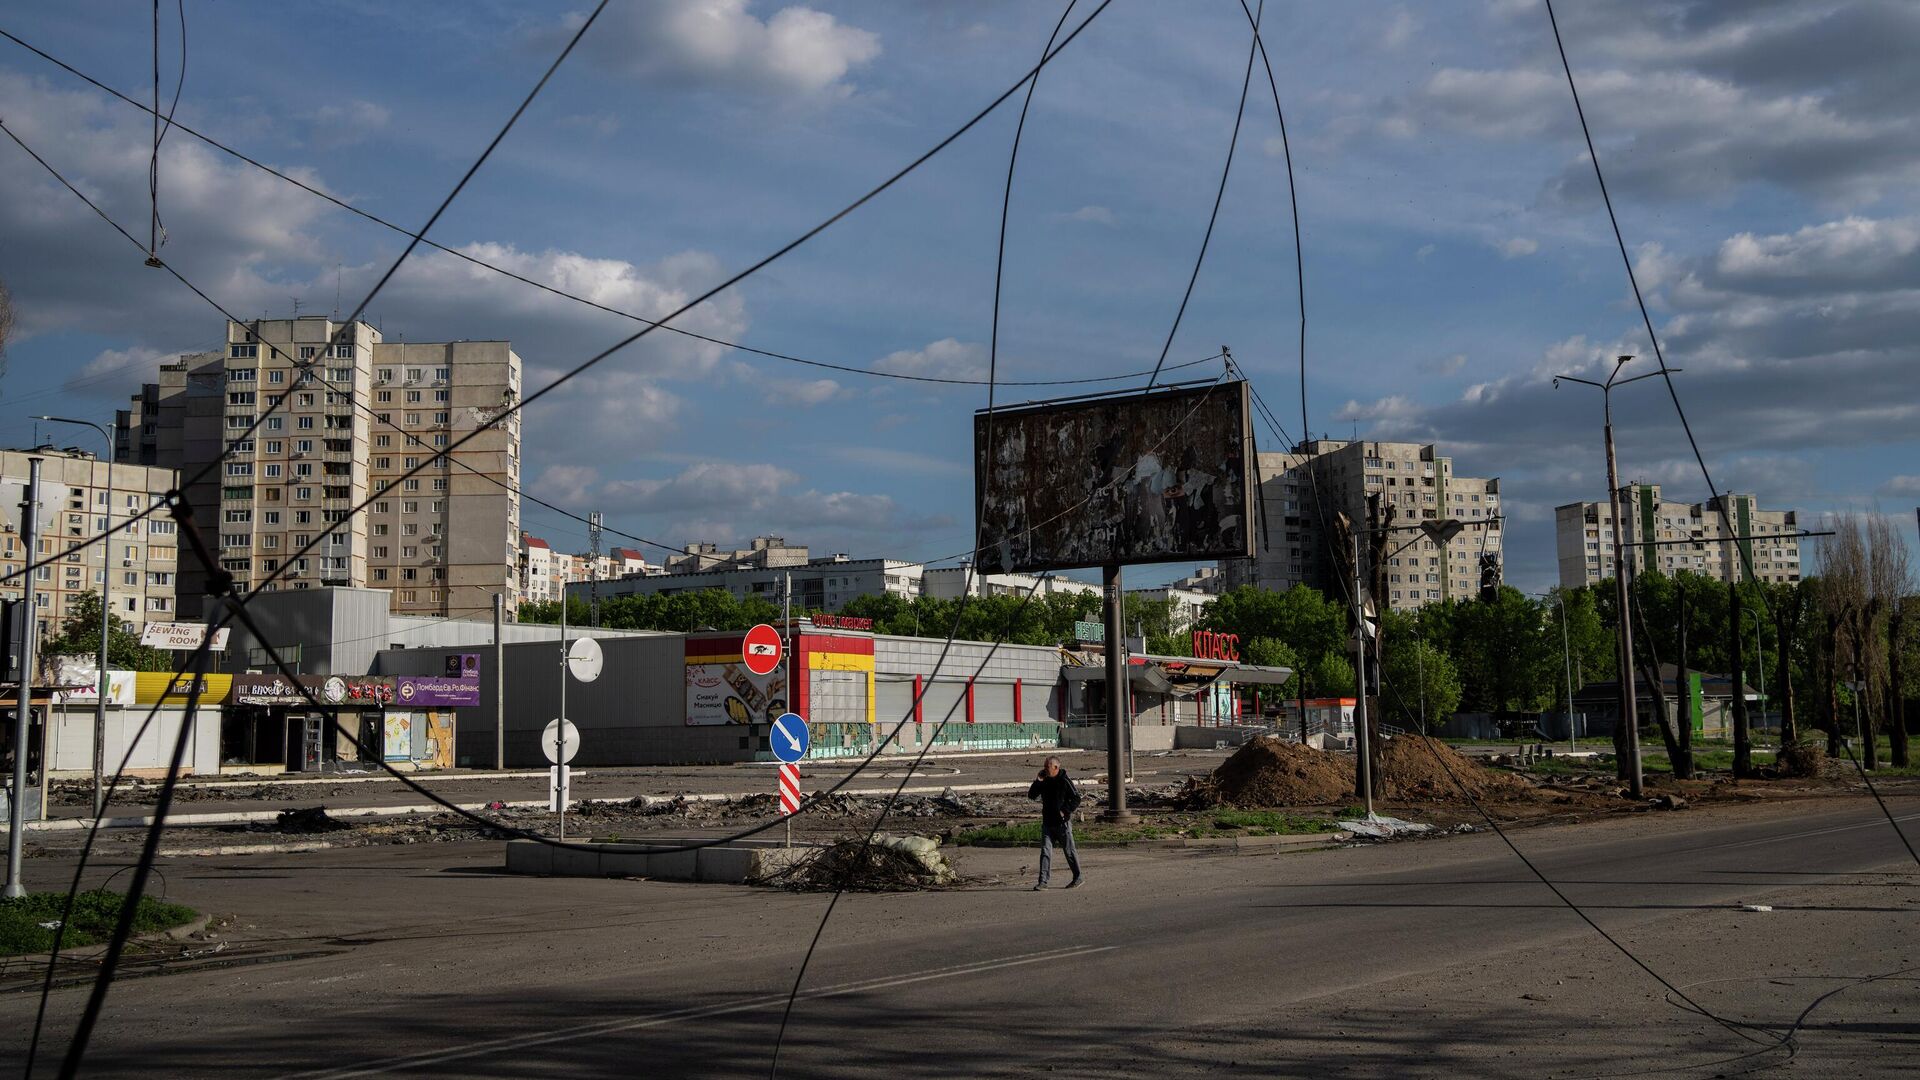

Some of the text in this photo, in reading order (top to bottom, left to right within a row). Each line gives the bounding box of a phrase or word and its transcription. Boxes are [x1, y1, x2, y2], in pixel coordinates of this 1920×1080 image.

[150, 626, 190, 636] SEWING
[169, 637, 198, 645] ROOM
[1193, 630, 1240, 661] КЛАСС
[696, 693, 719, 701] Смакуй
